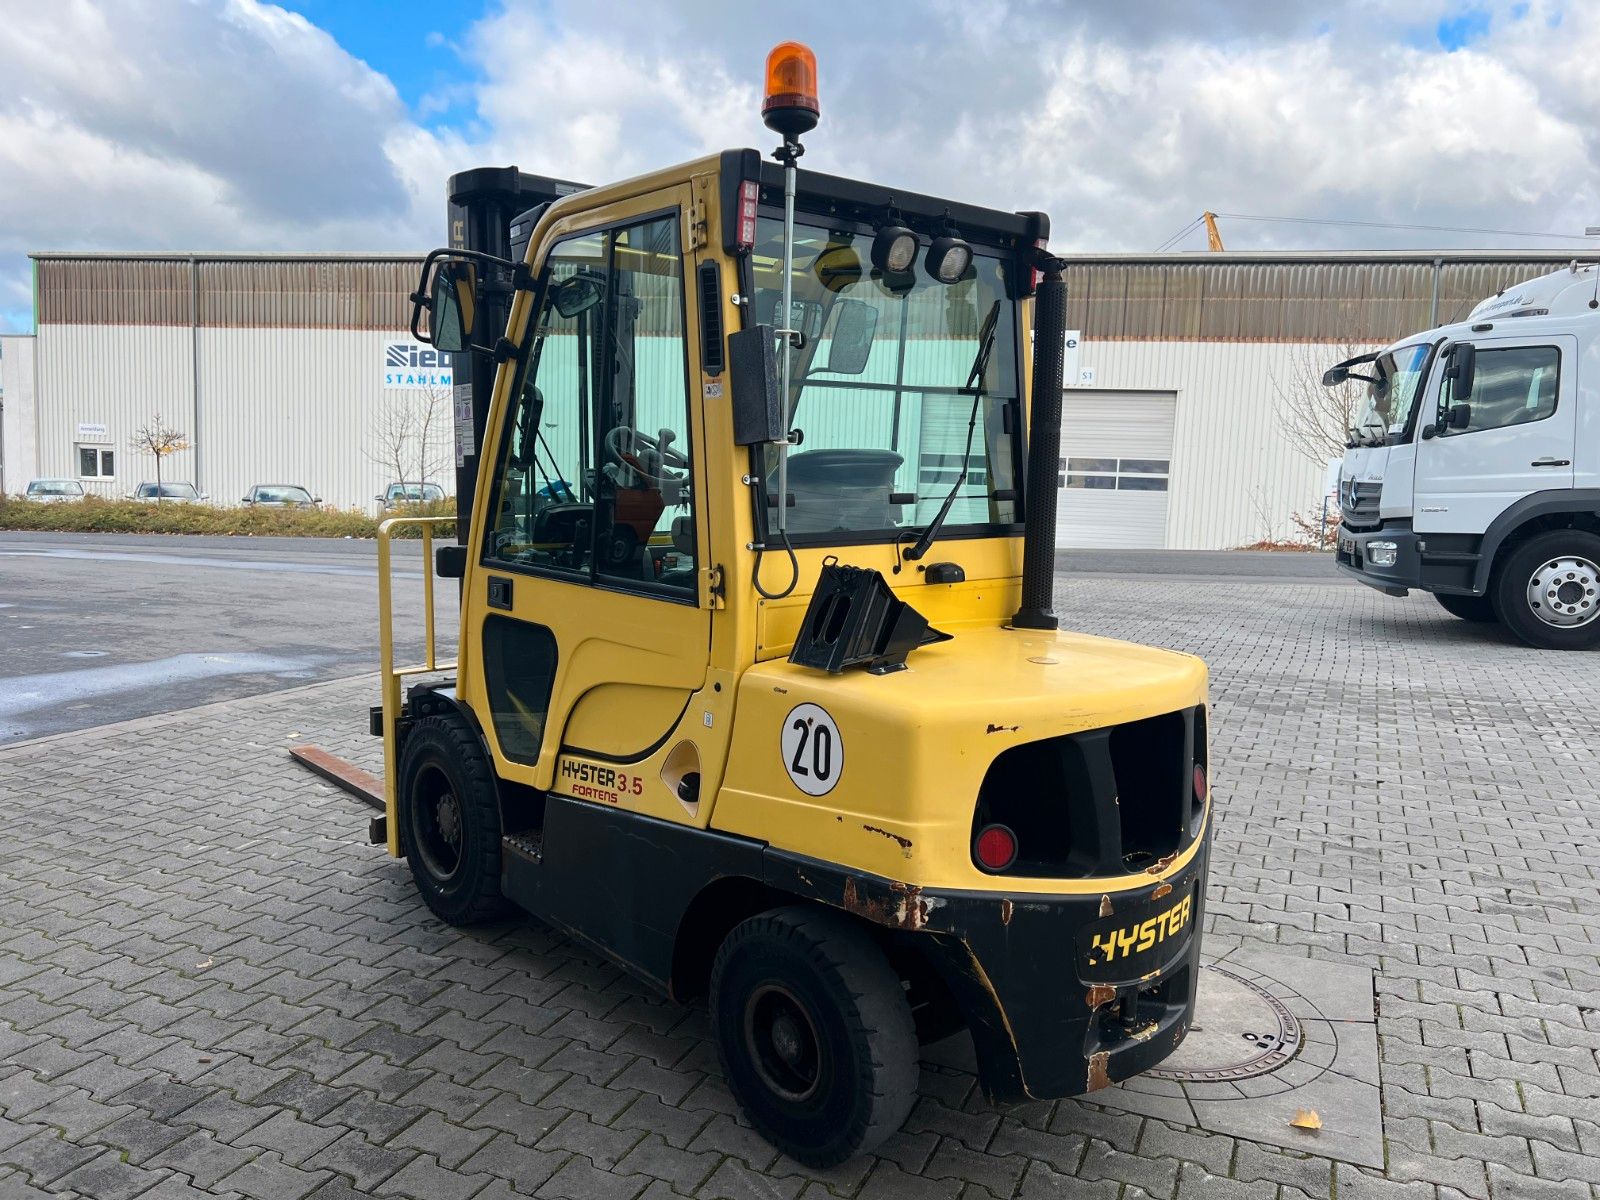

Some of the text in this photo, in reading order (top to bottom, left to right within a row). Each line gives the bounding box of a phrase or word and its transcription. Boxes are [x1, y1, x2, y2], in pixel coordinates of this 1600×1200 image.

[792, 718, 832, 781] 20
[562, 760, 643, 795] HYSTER 3.5
[572, 784, 618, 803] FORTENS
[1089, 894, 1191, 966] HYSTER
